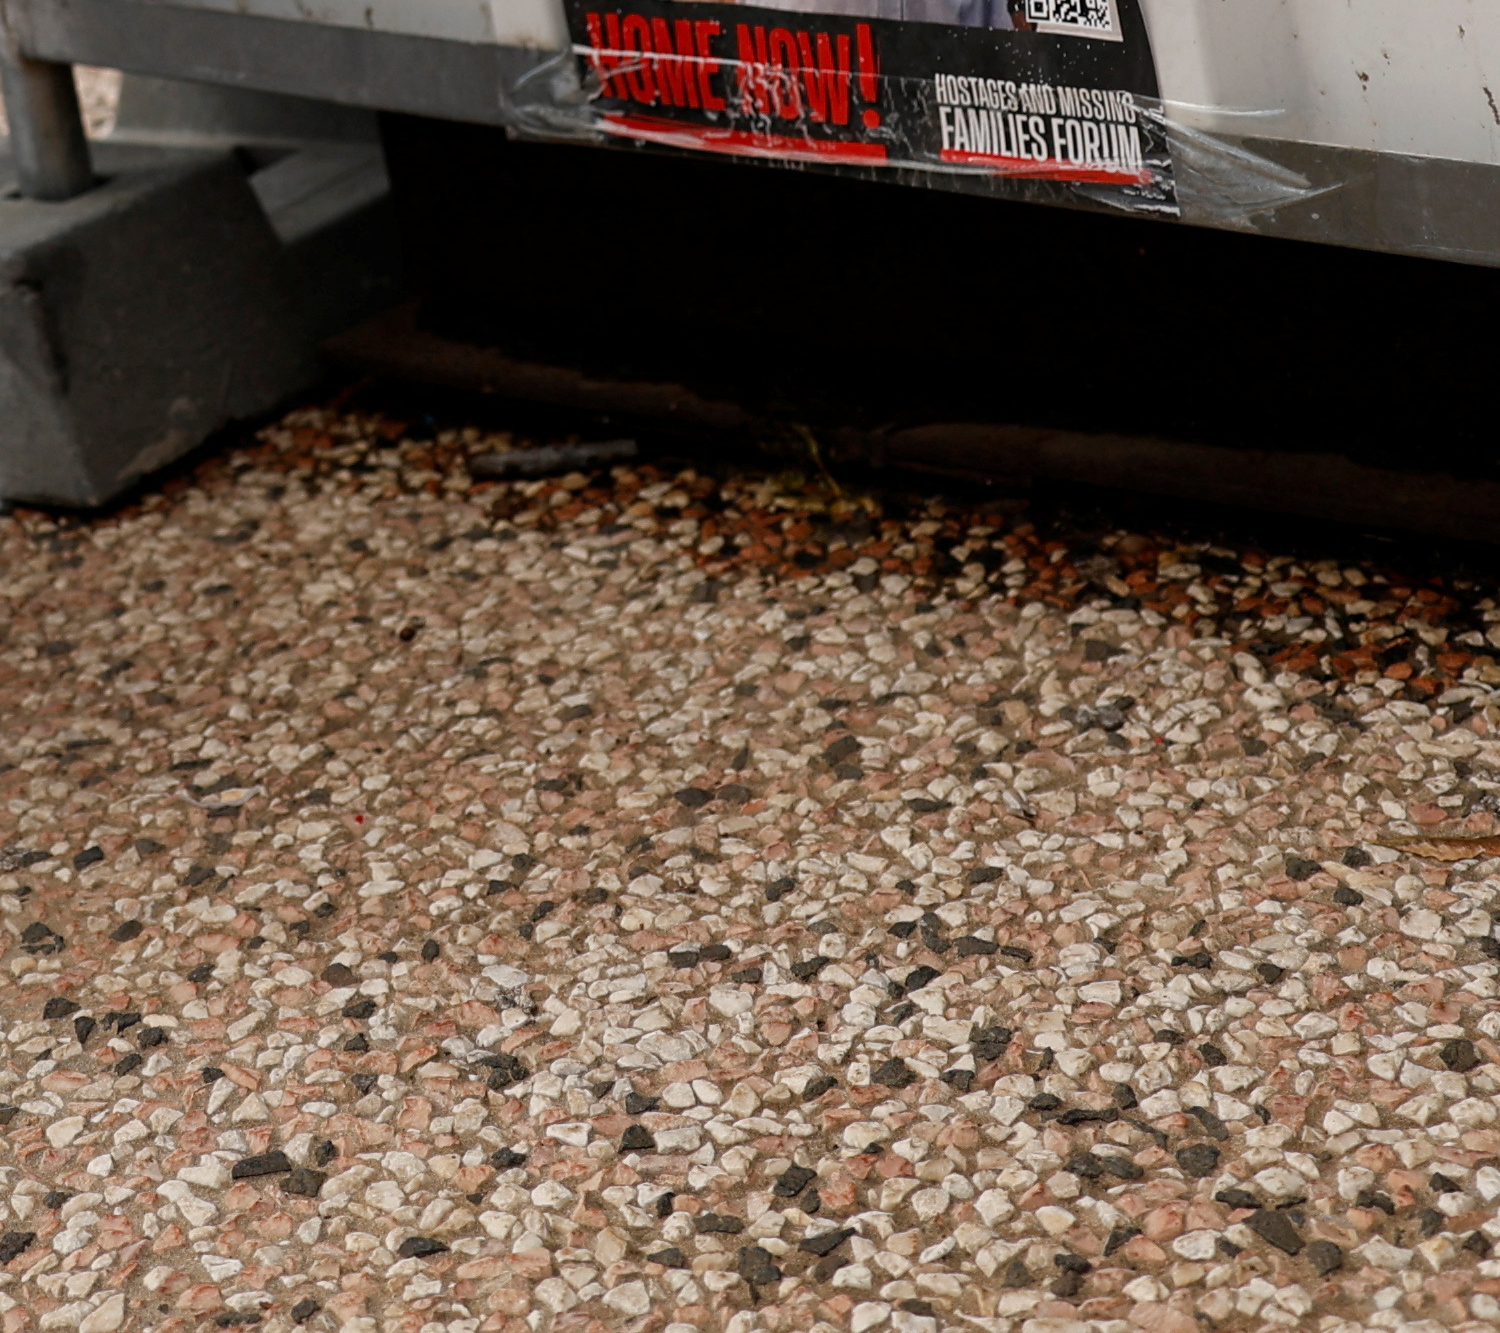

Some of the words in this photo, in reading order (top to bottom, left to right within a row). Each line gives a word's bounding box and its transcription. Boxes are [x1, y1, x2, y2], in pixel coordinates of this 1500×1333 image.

[585, 11, 728, 112] HOME
[736, 22, 882, 130] NOW!
[934, 72, 1019, 113] HOSTAGES
[1018, 82, 1057, 116] AND
[1057, 85, 1137, 125] MISSING
[939, 106, 1049, 163] FAMILIES
[1050, 117, 1143, 173] FORUM
